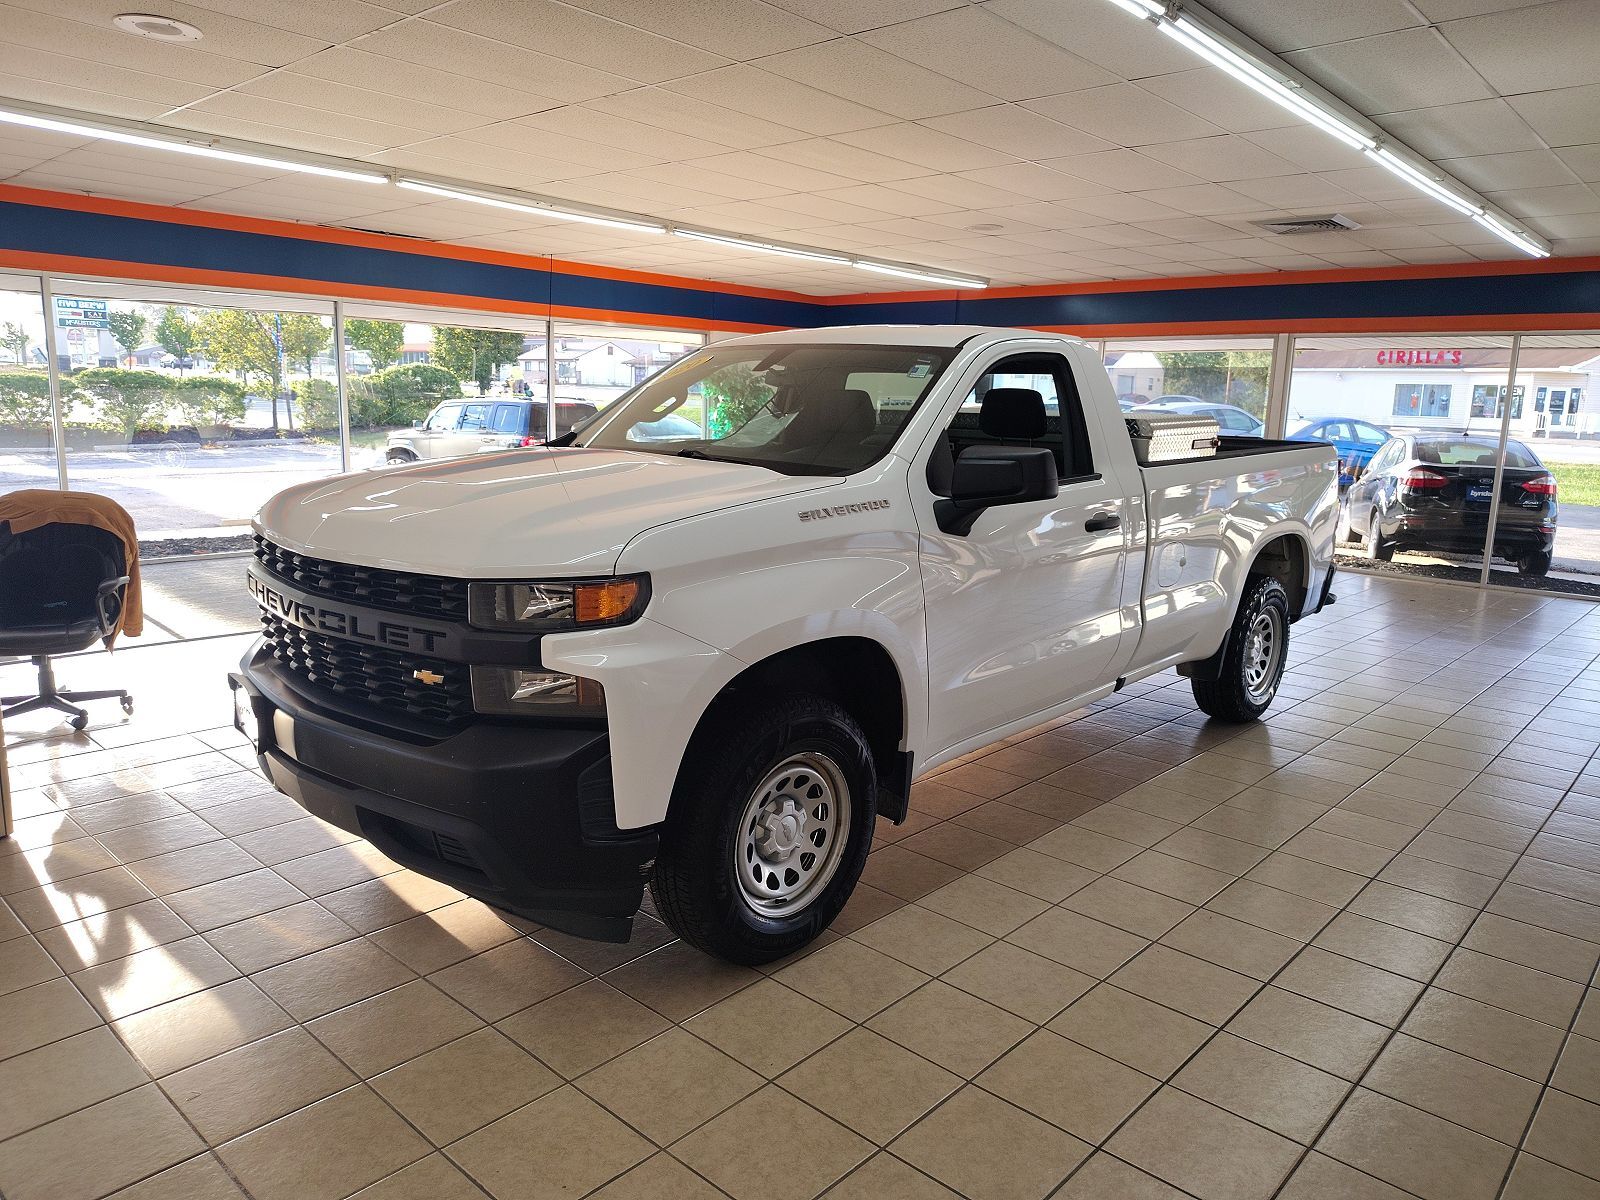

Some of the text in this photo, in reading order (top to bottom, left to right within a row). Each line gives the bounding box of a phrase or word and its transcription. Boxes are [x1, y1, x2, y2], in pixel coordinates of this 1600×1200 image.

[1376, 350, 1462, 366] CIRILLA'S
[1501, 386, 1524, 396] OEN
[798, 499, 890, 522] SILVERADO
[248, 572, 447, 652] CHEVROLET
